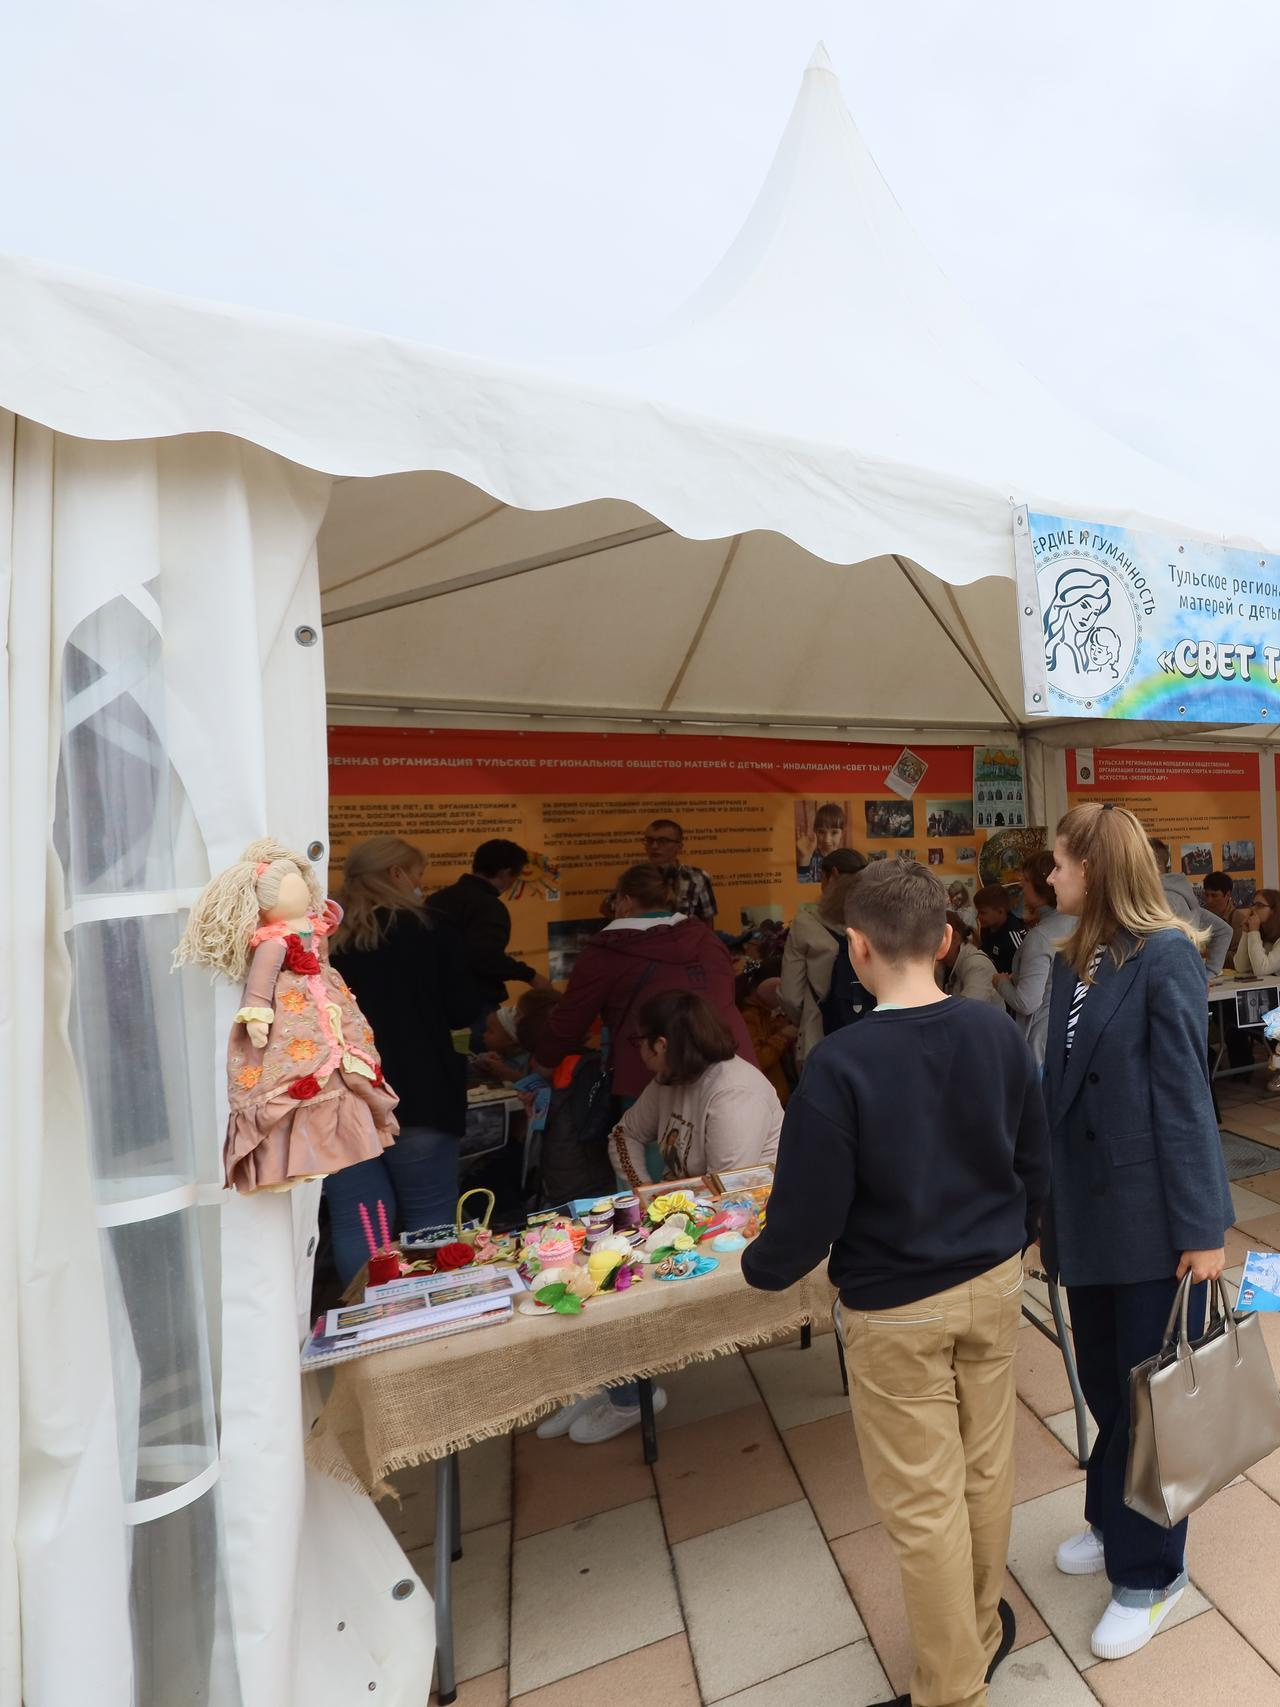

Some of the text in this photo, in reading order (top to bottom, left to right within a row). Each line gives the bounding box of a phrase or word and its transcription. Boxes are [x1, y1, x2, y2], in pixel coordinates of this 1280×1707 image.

[1079, 530, 1088, 546] И
[1092, 535, 1156, 616] ГУМАННОСТЬ
[1168, 564, 1227, 591] Тульское
[1179, 595, 1234, 616] матерей
[1238, 603, 1245, 617] с
[1157, 638, 1256, 682] «СВЕТ
[382, 757, 473, 767] ОРГАНИЗАЦИЯ
[476, 758, 536, 768] ТУЛЬСКОЕ
[539, 758, 624, 769] РЕГИОНАЛЬНОЕ
[626, 759, 682, 769] ОБЩЕСТВО
[684, 760, 728, 769] МАТЕРЕЙ
[729, 761, 735, 769] С
[737, 761, 774, 771] ДЕТЬМИ
[782, 763, 841, 772] ИНВАЛИДАМИ
